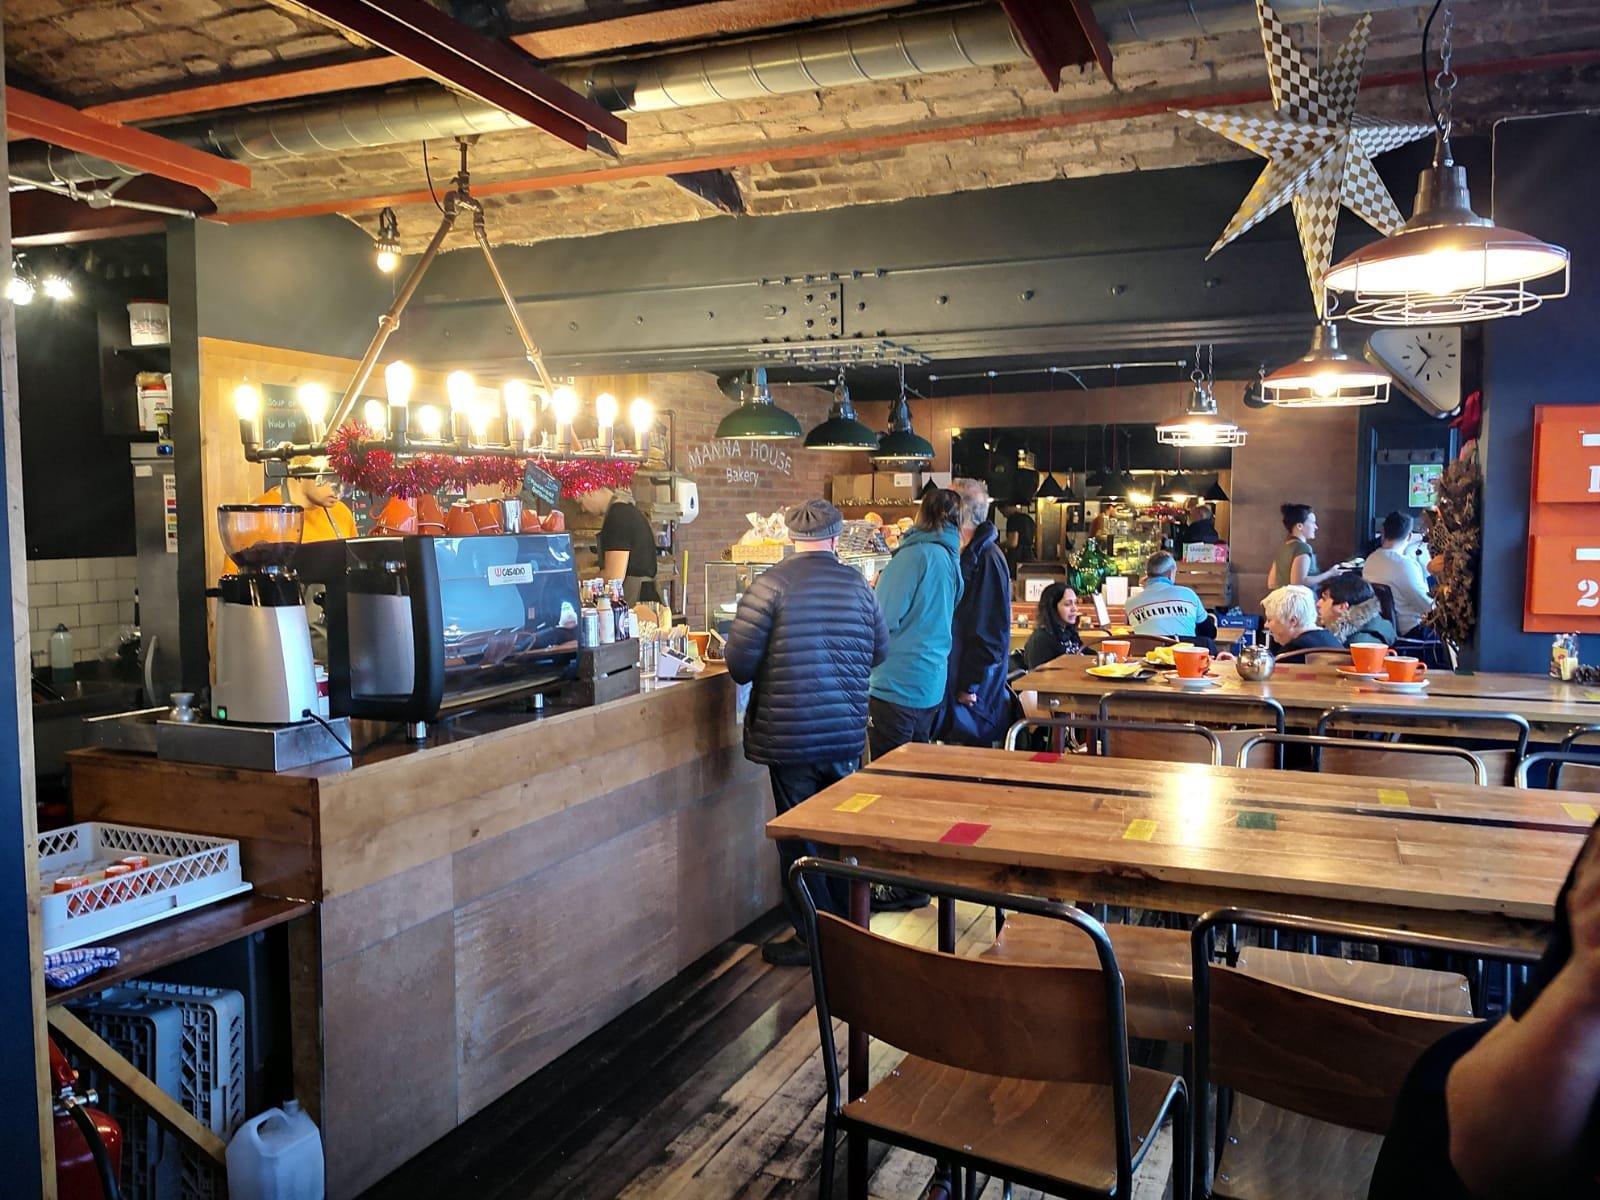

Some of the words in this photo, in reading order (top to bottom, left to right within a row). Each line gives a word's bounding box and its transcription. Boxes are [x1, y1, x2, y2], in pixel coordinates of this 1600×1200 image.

[686, 439, 741, 472] MANNA
[750, 440, 793, 476] HOUSE
[726, 467, 759, 487] Bakery
